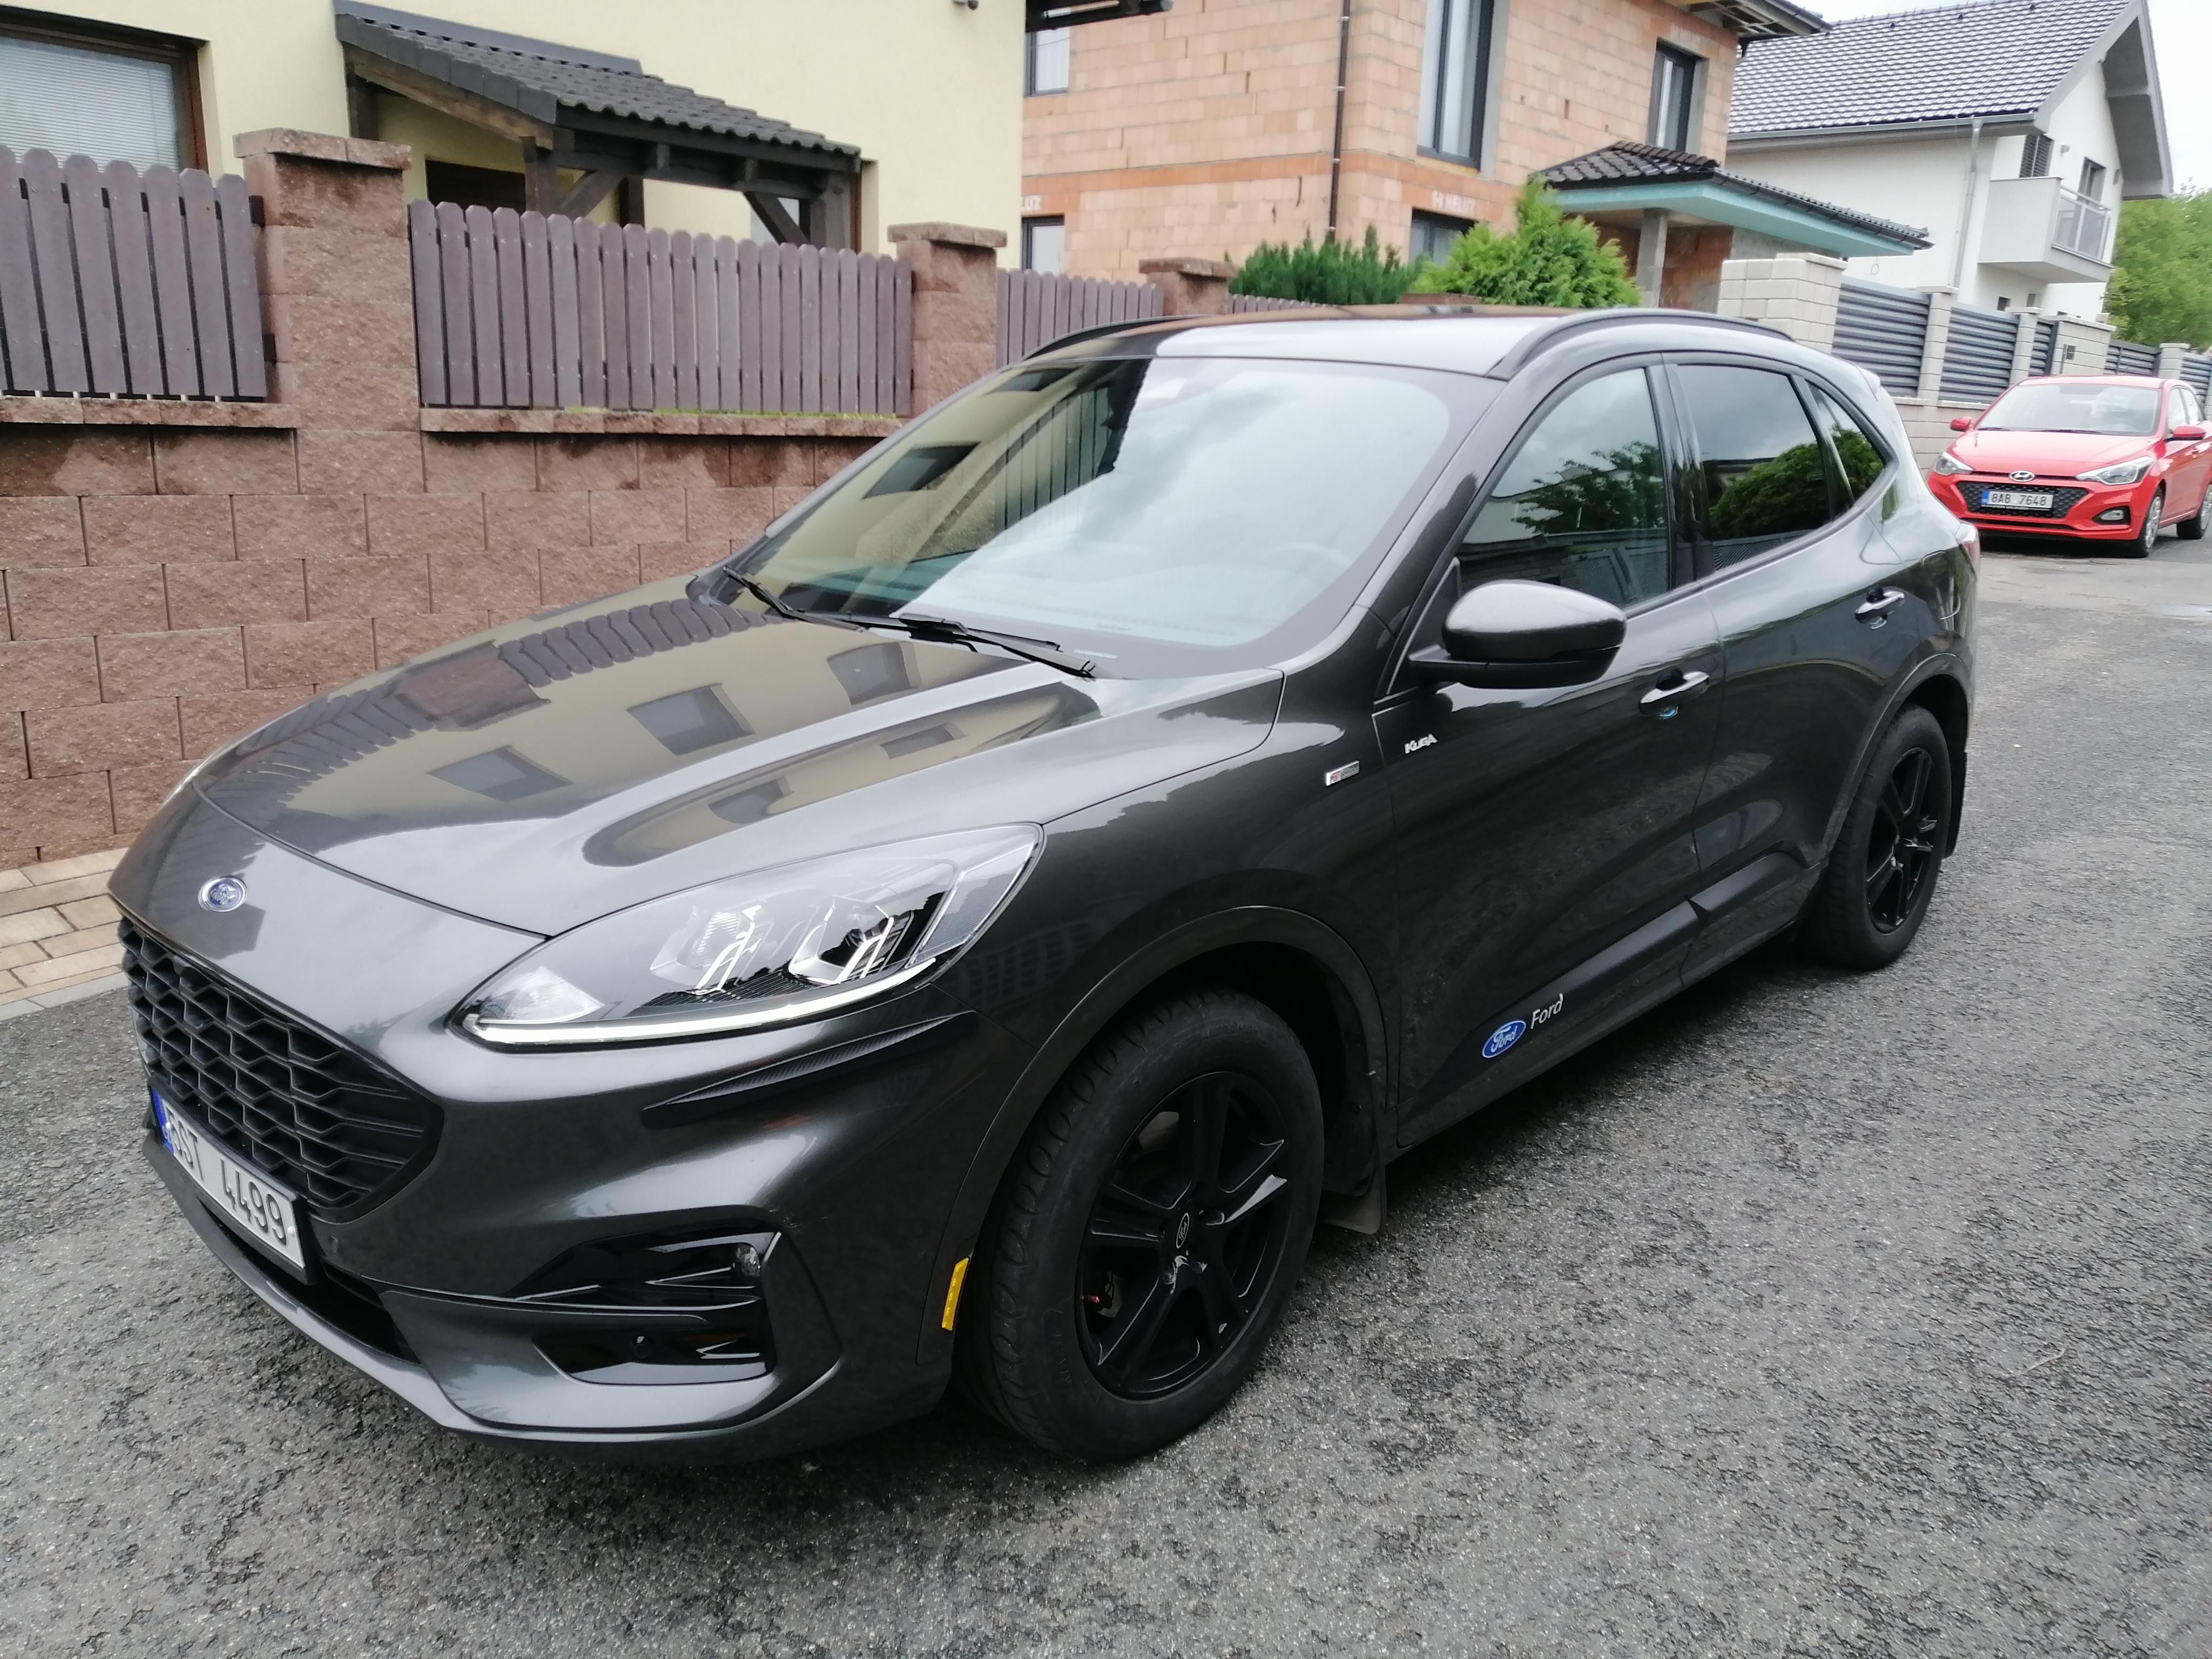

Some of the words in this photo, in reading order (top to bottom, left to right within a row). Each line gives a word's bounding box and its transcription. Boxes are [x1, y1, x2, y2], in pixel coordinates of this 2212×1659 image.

[1991, 493, 2011, 503] 8AB
[2019, 495, 2047, 506] 7648
[1491, 1026, 1519, 1053] Ford
[1529, 993, 1563, 1029] Ford
[220, 1158, 287, 1246] 4499
